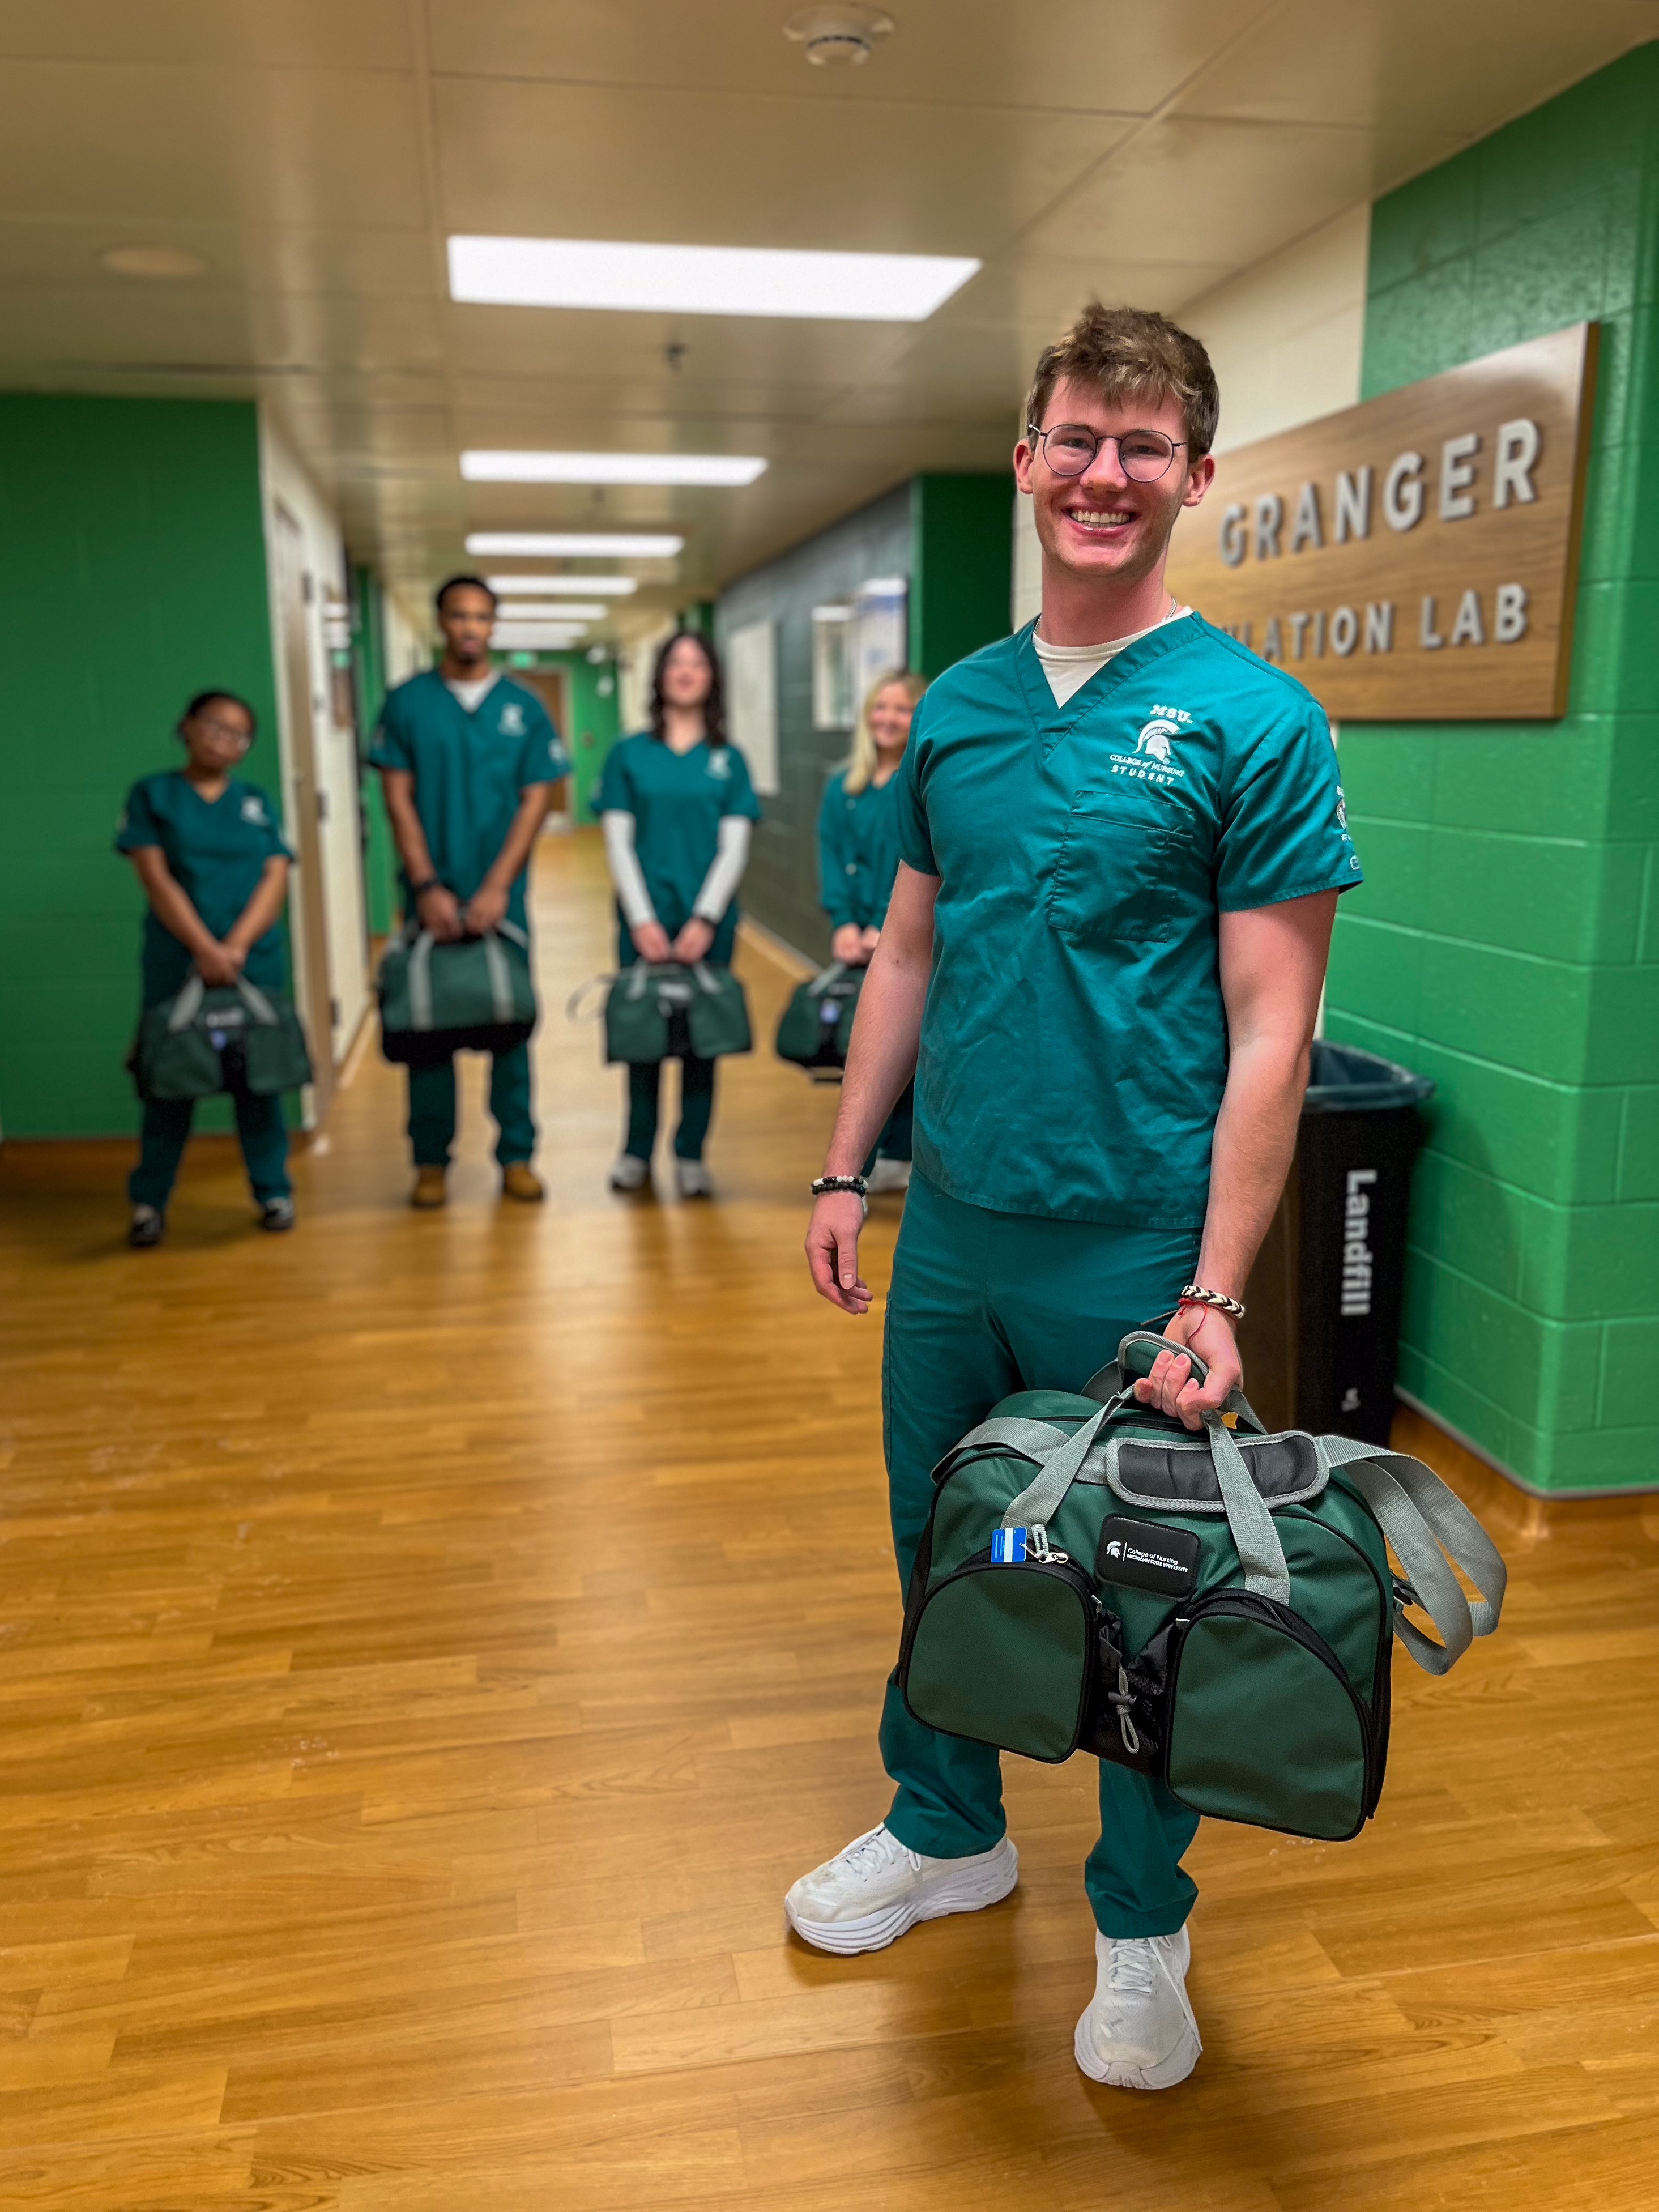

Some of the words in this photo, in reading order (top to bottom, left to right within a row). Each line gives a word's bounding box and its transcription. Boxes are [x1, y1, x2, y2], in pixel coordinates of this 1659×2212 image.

[1218, 417, 1541, 567] GRANGER
[1419, 582, 1528, 650] LAB
[1111, 764, 1175, 785] STUDENT
[1151, 762, 1185, 777] NURSING
[1341, 1169, 1378, 1316] Landfill
[1127, 1553, 1150, 1563] MICHIGAN
[1163, 1562, 1189, 1573] UNIVERSITY
[1128, 1548, 1149, 1558] College
[1157, 1554, 1179, 1566] Nursing
